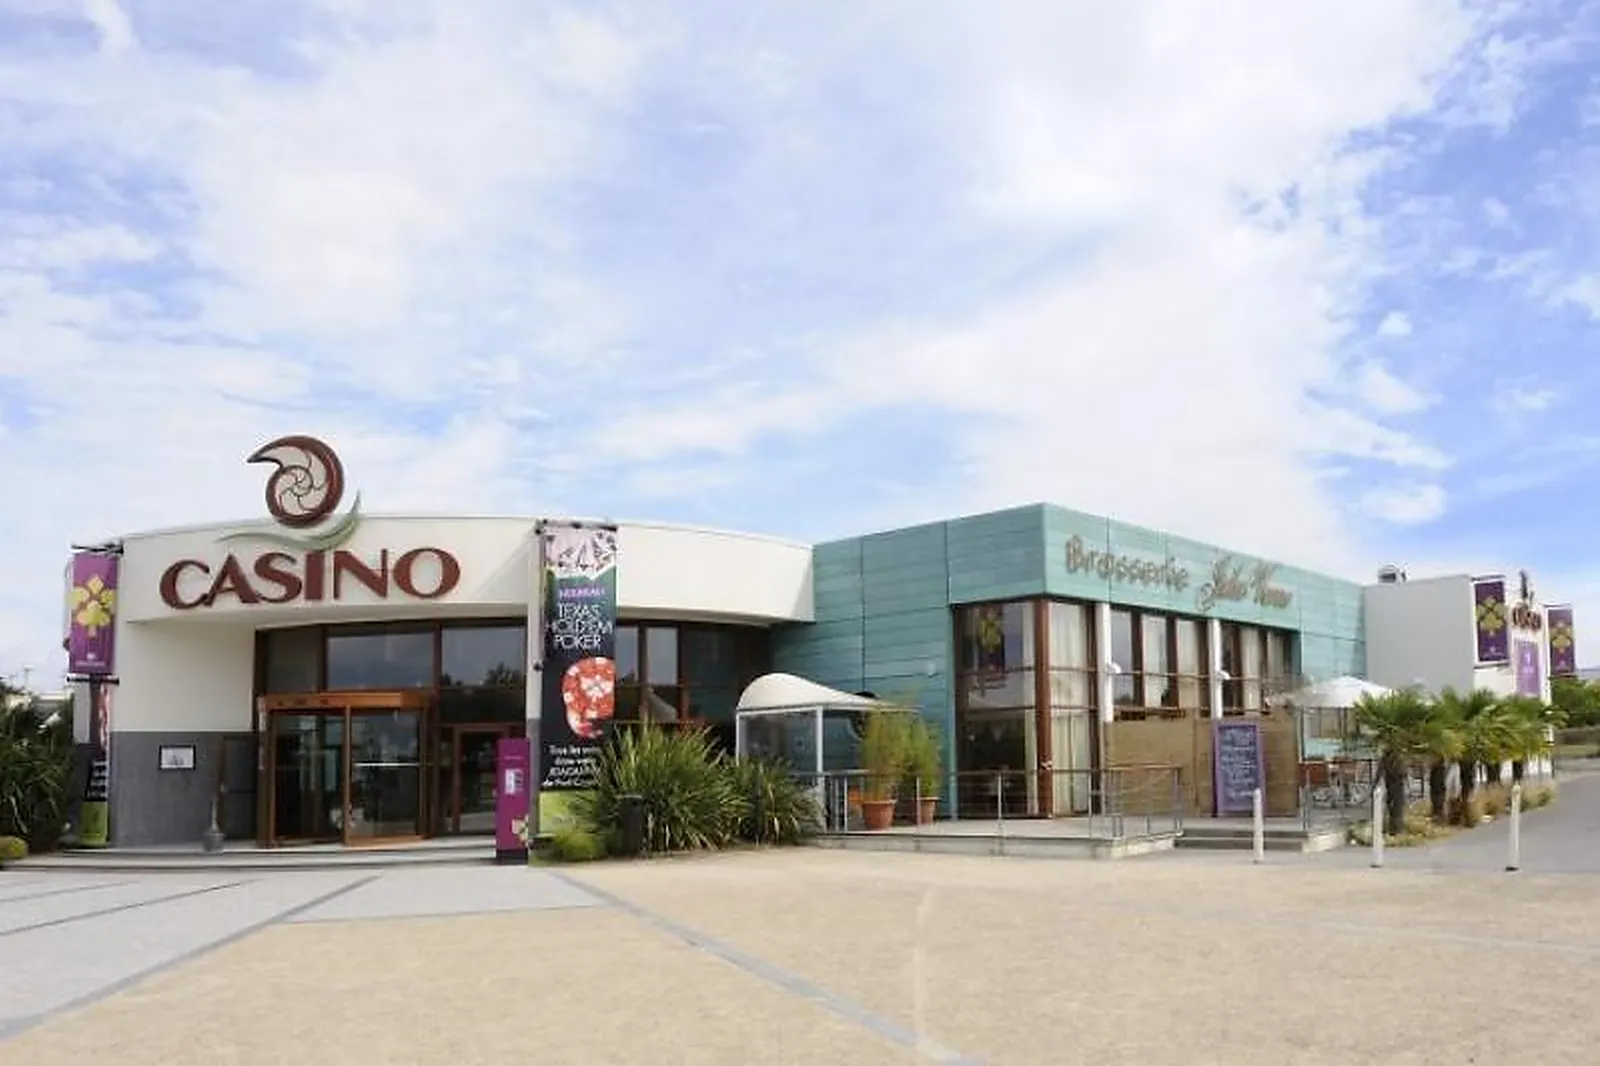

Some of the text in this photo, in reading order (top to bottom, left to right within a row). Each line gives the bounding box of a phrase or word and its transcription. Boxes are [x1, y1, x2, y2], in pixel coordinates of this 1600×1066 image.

[159, 547, 461, 609] CASINO
[1064, 533, 1189, 592] Brasserie
[557, 602, 602, 621] TEXAS
[553, 634, 602, 650] POKER
